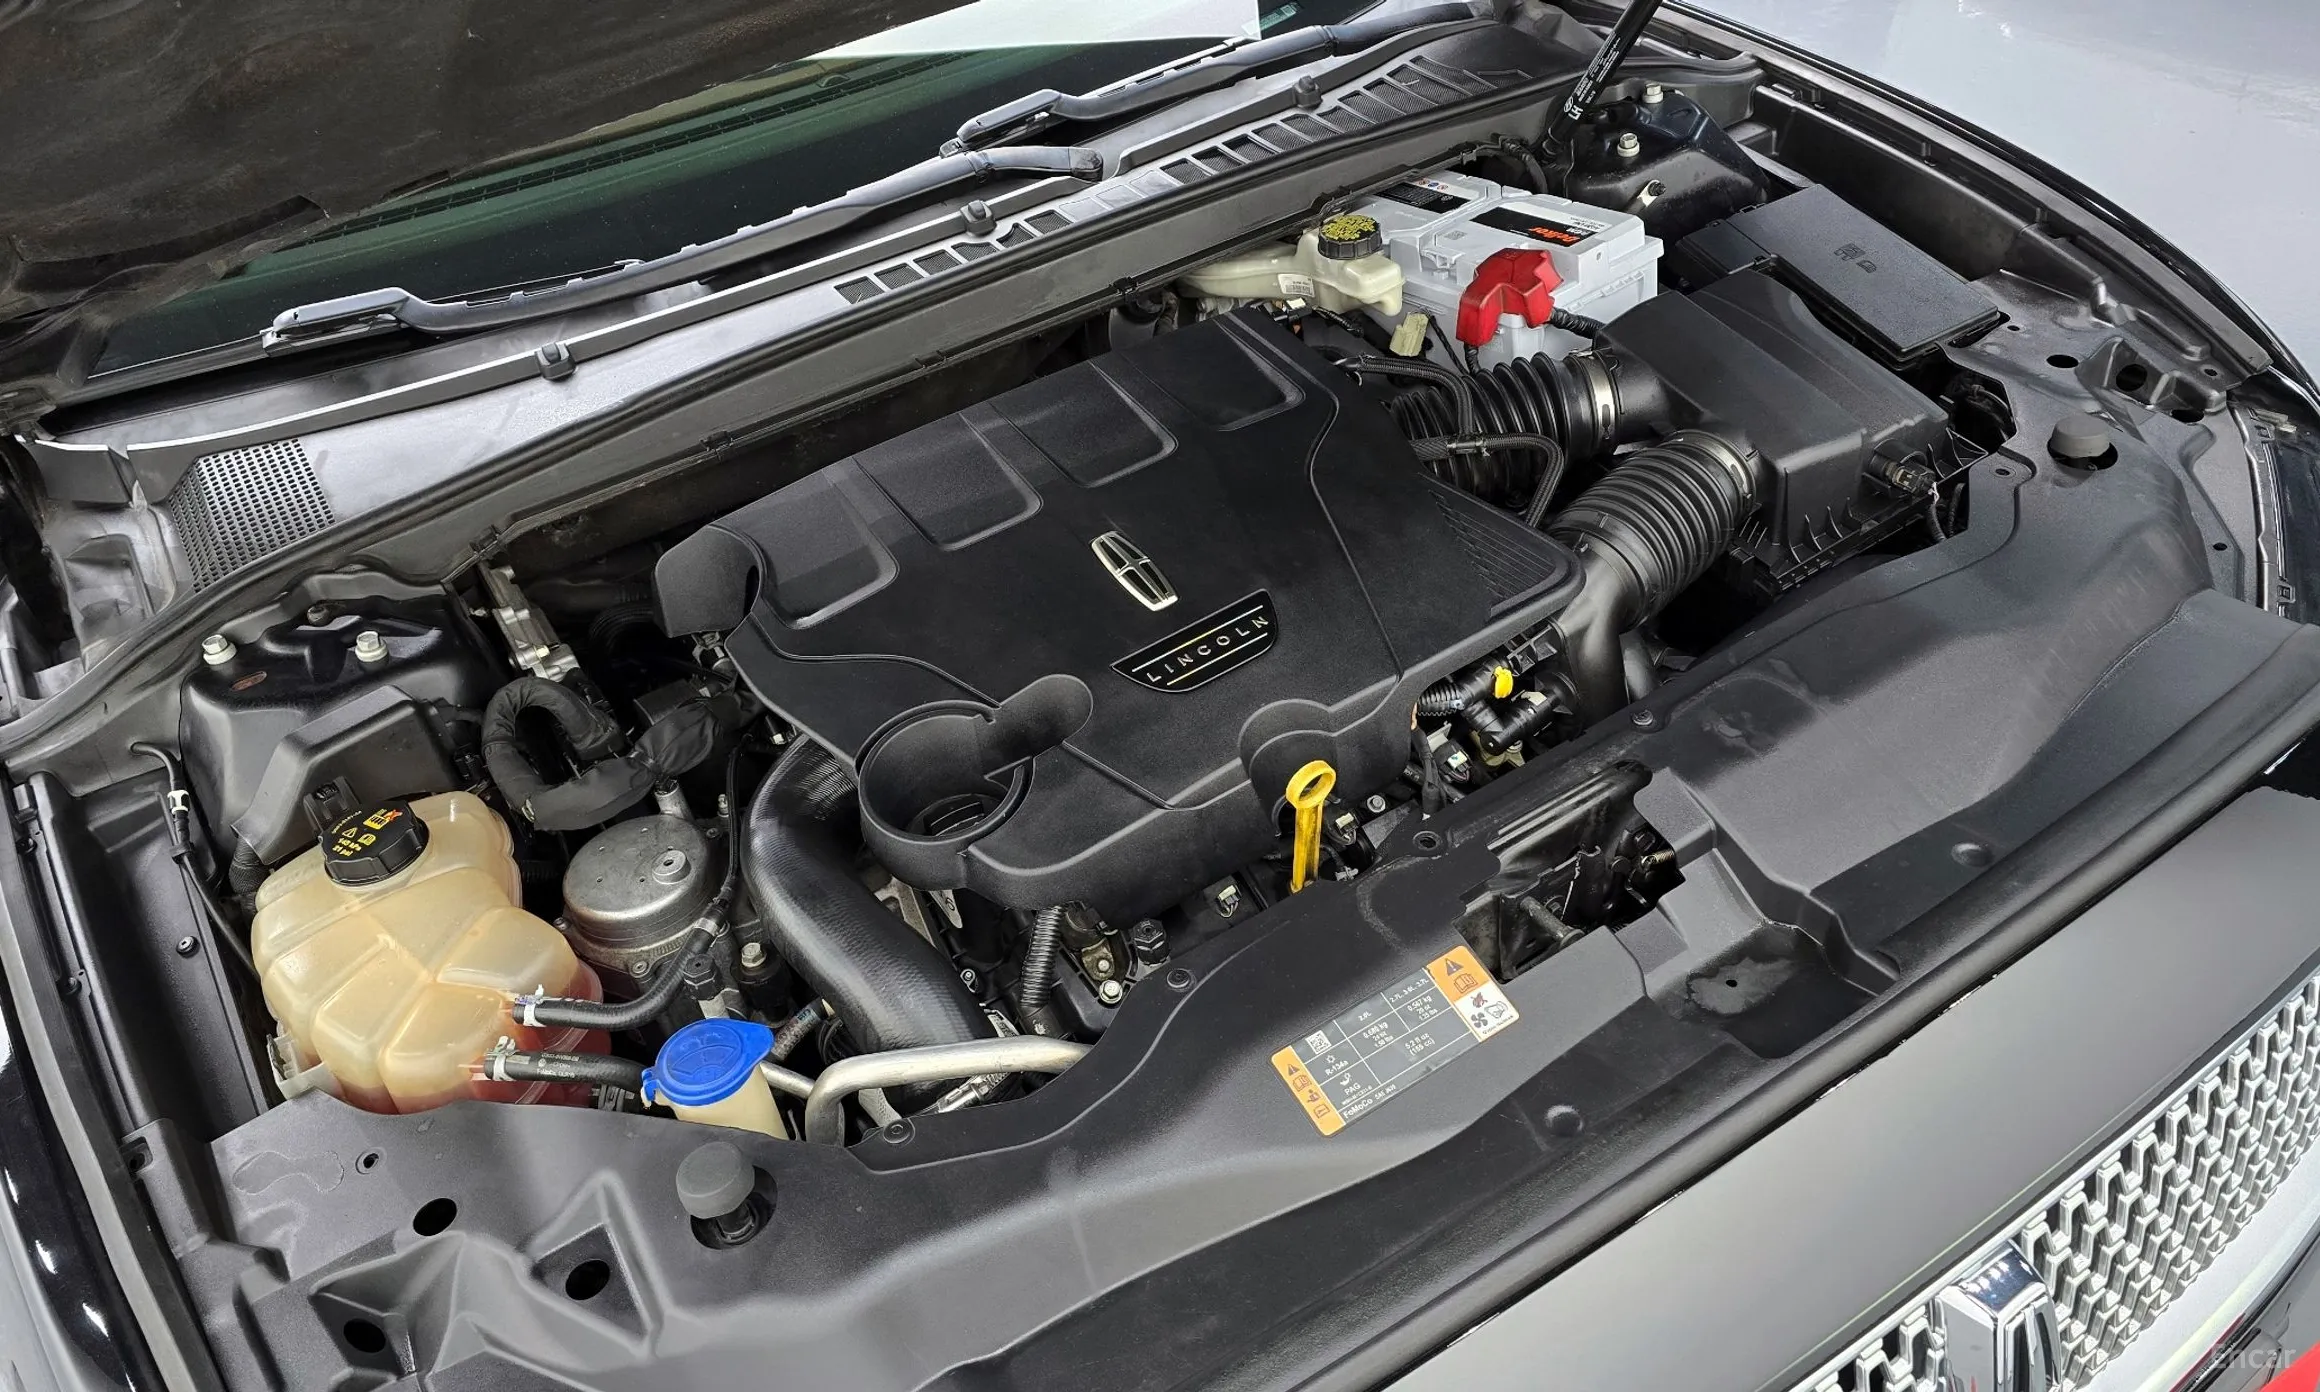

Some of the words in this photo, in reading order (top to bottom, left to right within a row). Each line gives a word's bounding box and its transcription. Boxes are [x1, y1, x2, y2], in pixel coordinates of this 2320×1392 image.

[1568, 104, 1583, 120] LH
[1147, 616, 1269, 682] LINCOLN
[1421, 993, 1432, 1004] kg
[1343, 1081, 1361, 1095] PAG
[1342, 1096, 1374, 1119] FoMoCo
